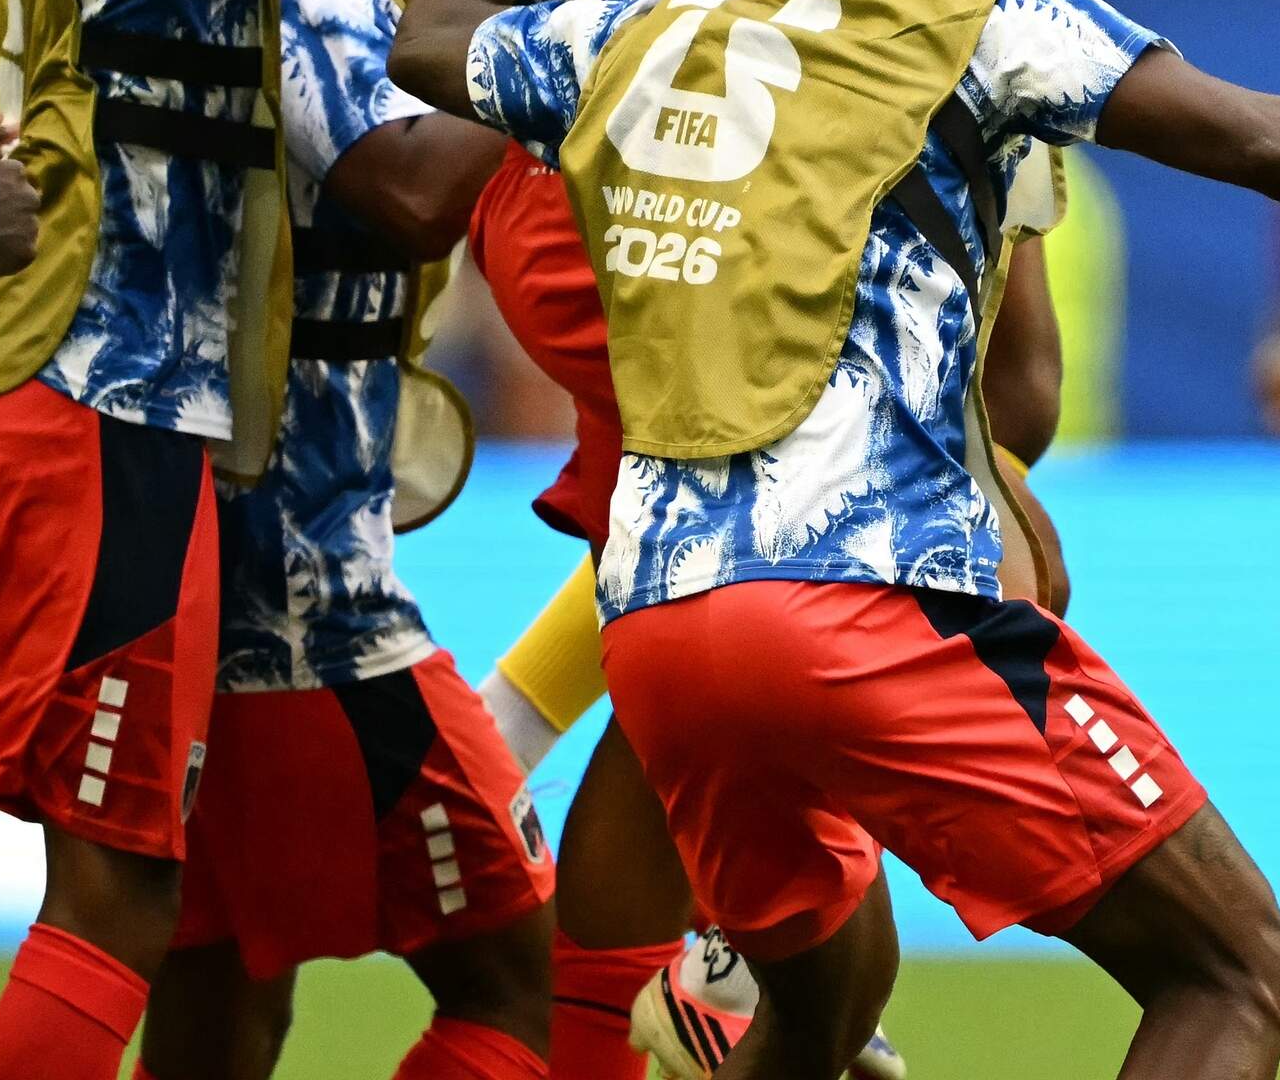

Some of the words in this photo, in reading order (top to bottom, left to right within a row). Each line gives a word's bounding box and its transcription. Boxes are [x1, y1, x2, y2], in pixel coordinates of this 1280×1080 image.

[652, 106, 719, 149] FIFA
[602, 184, 685, 224] WORLD
[686, 197, 742, 233] CUP
[603, 223, 723, 286] 2026
